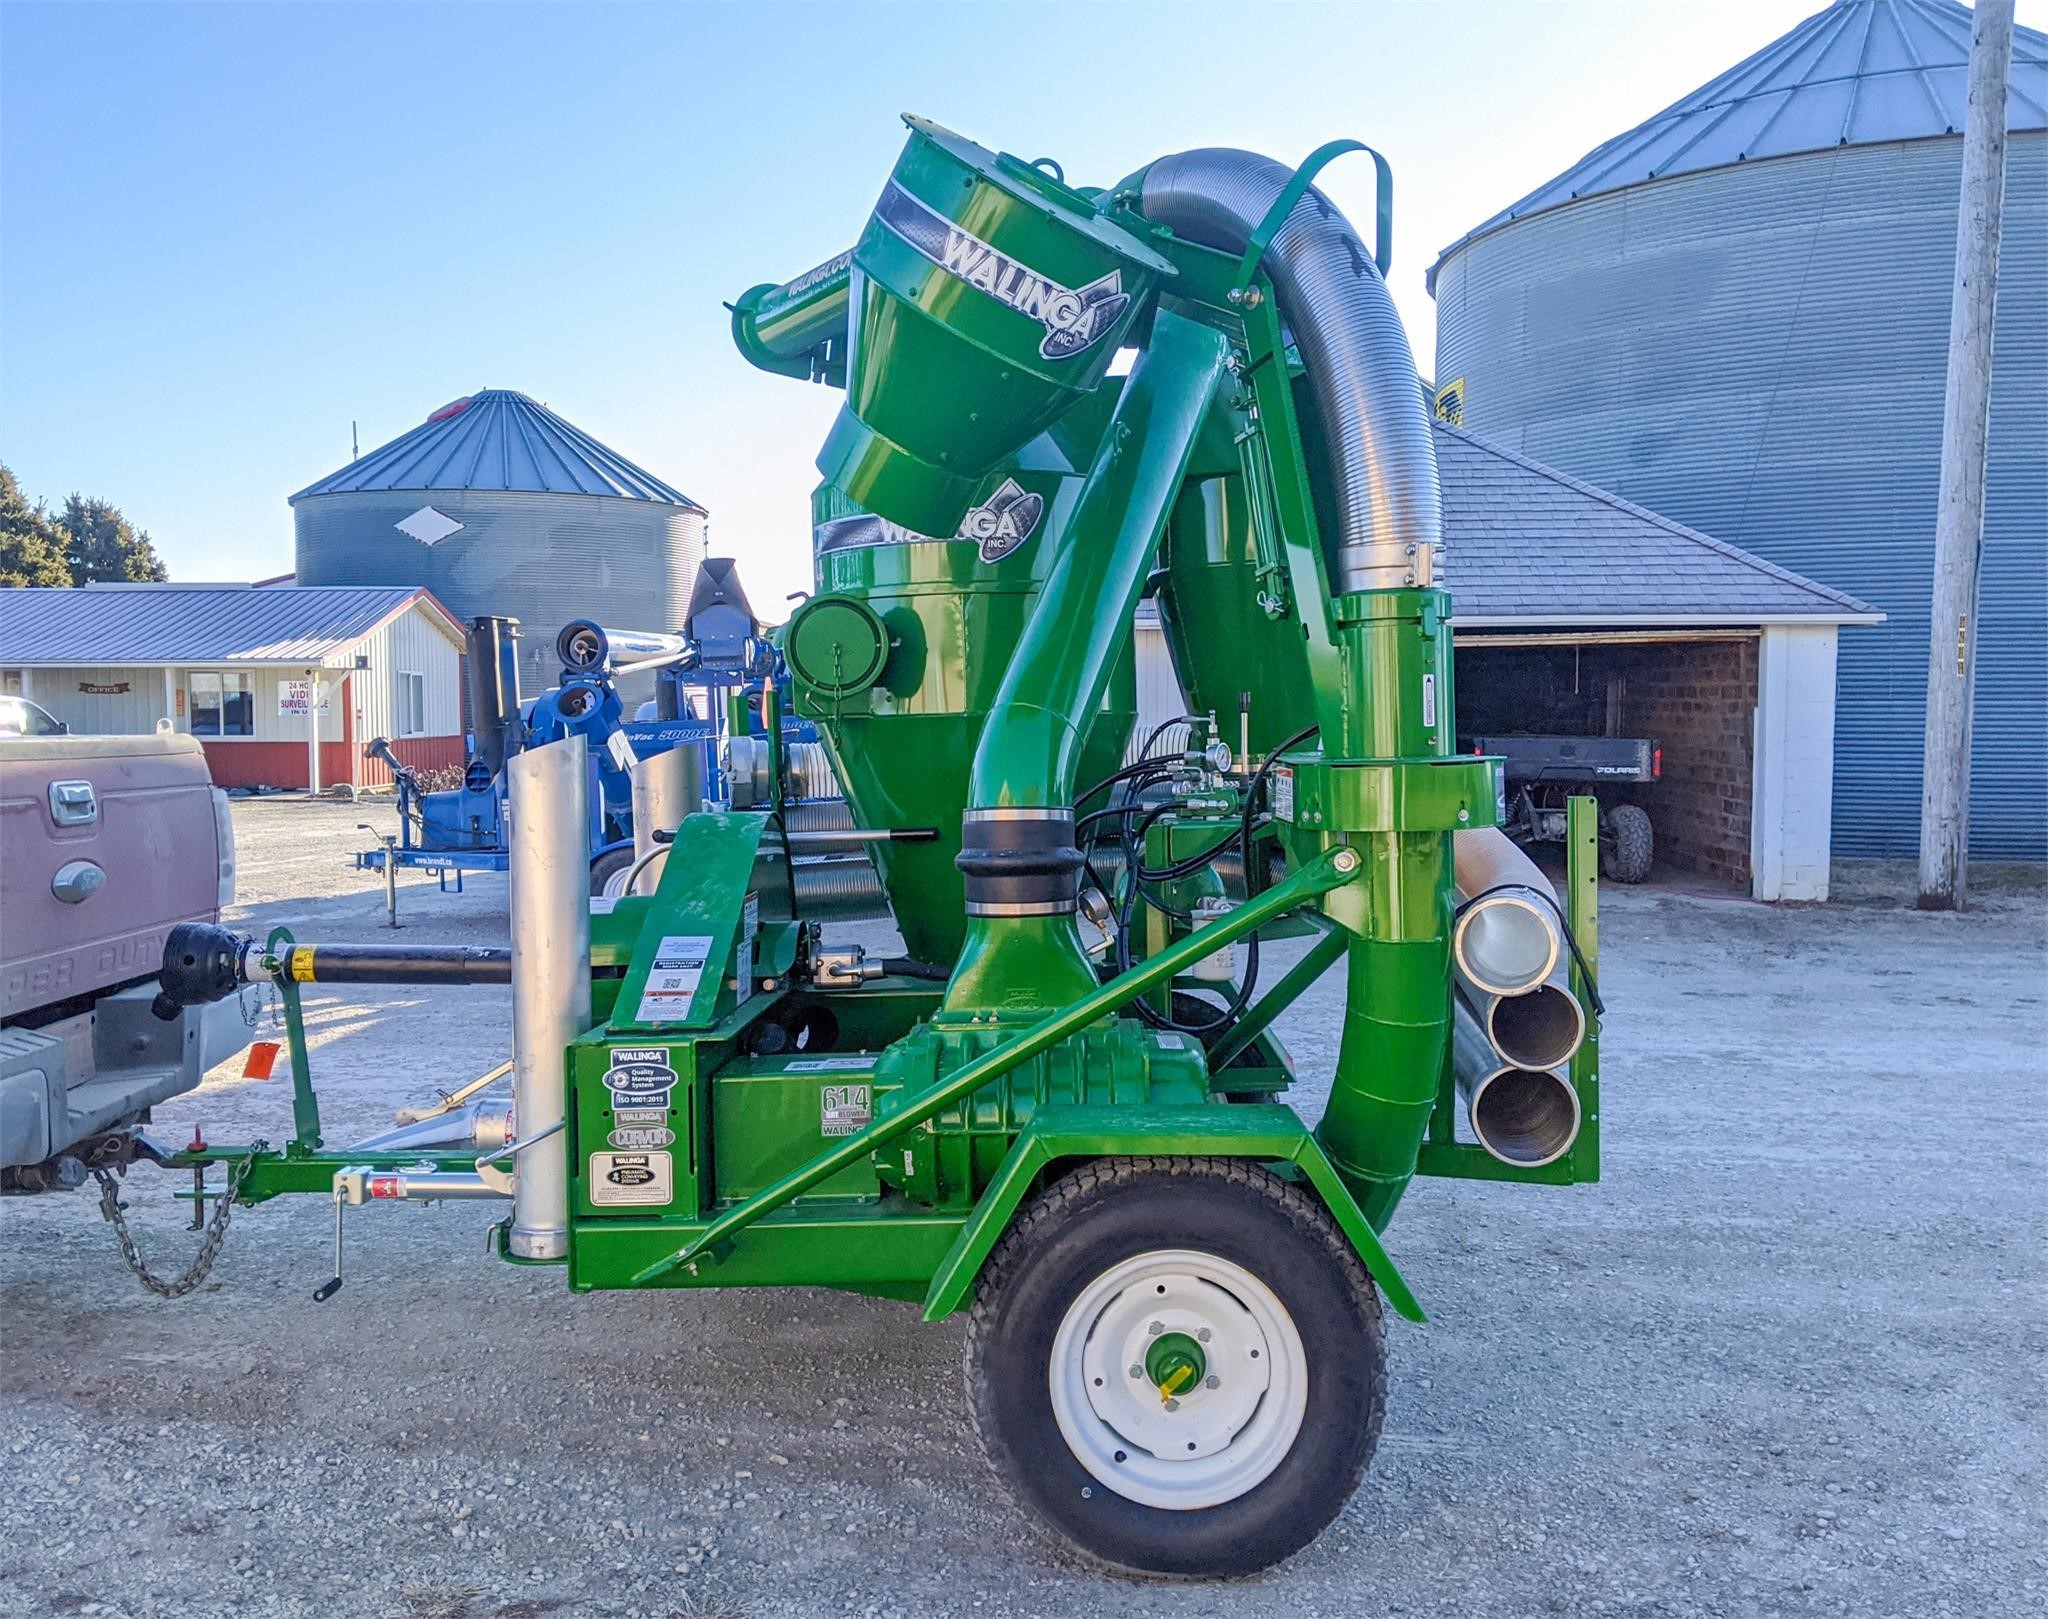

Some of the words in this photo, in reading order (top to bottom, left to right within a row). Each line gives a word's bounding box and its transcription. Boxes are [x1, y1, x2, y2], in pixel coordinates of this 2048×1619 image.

[944, 229, 1096, 343] WALINGA
[1055, 332, 1073, 348] INC.
[987, 539, 1007, 549] INC.
[618, 1052, 662, 1061] WALINGA
[823, 1086, 869, 1111] 614
[620, 1112, 662, 1121] WALINGA
[823, 1125, 863, 1135] WALING
